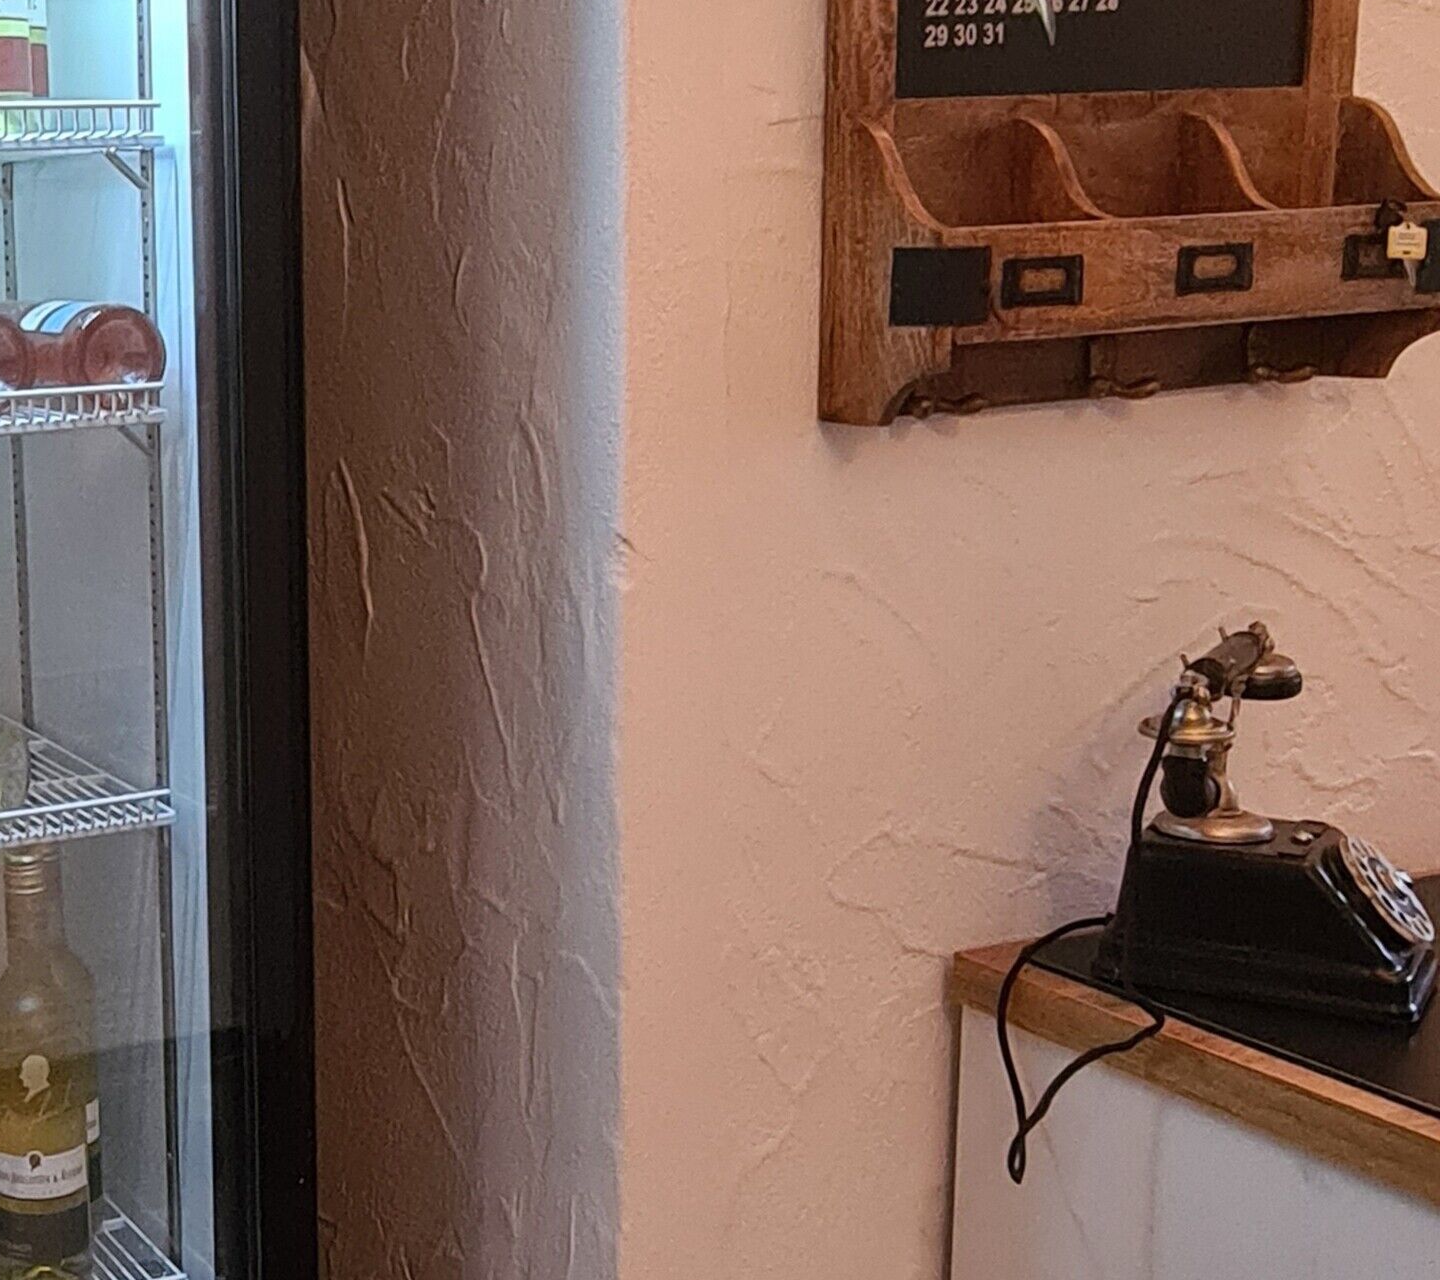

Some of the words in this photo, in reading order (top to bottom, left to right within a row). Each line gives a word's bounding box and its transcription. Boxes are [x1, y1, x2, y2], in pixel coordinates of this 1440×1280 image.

[924, 24, 948, 48] 29
[953, 23, 977, 46] 30
[983, 22, 1004, 45] 31
